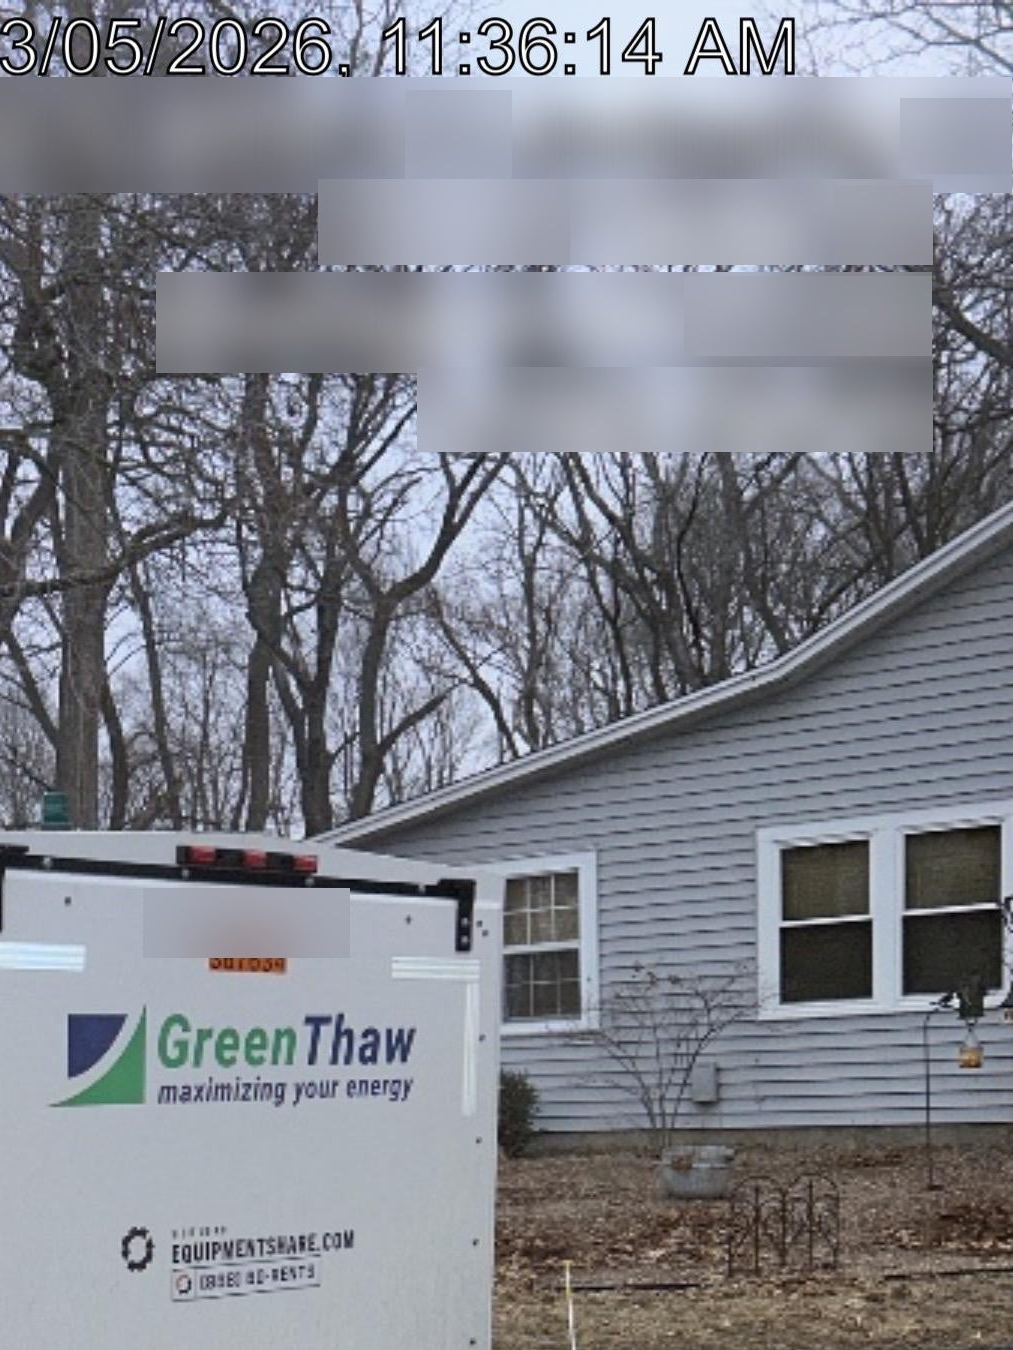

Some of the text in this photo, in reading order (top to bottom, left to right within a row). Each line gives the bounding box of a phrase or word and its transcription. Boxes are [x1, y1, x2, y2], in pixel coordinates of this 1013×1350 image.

[157, 1075, 414, 1107] maximizing your energy
[171, 1229, 355, 1264] EQUIPMENTSHARE.COM
